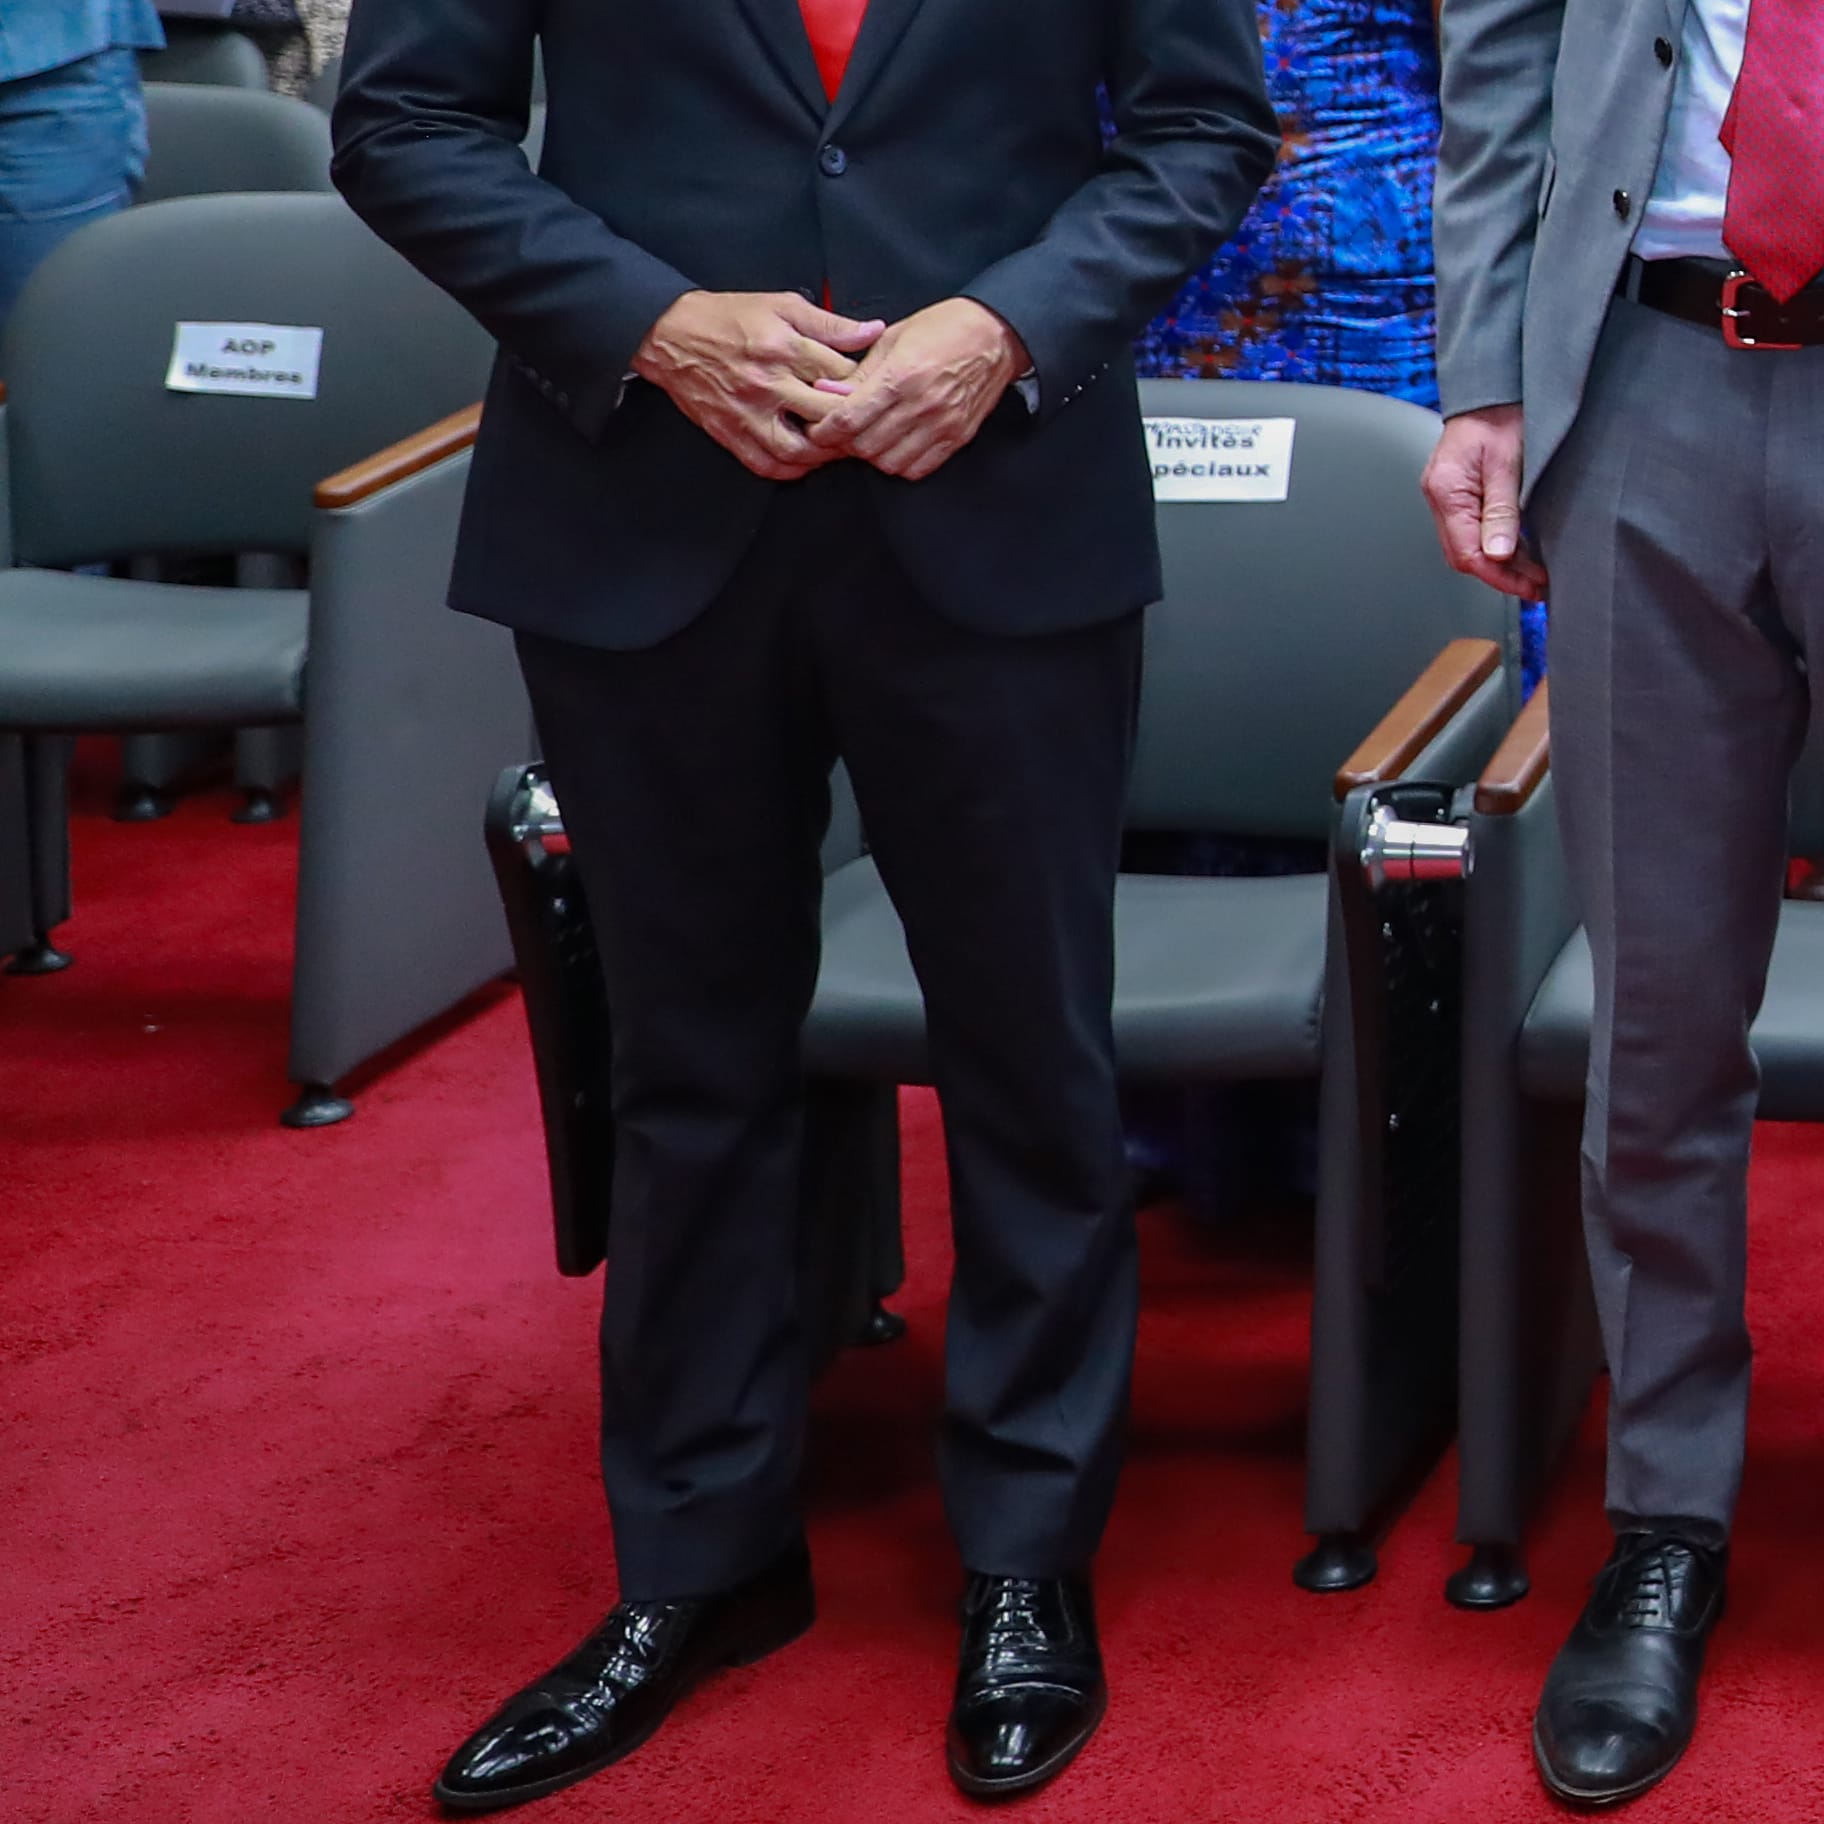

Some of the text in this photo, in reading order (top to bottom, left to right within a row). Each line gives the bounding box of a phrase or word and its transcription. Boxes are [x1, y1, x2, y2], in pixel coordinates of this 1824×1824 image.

[222, 337, 277, 356] AOP
[185, 363, 303, 384] Membres
[1154, 459, 1271, 479] péciaux
